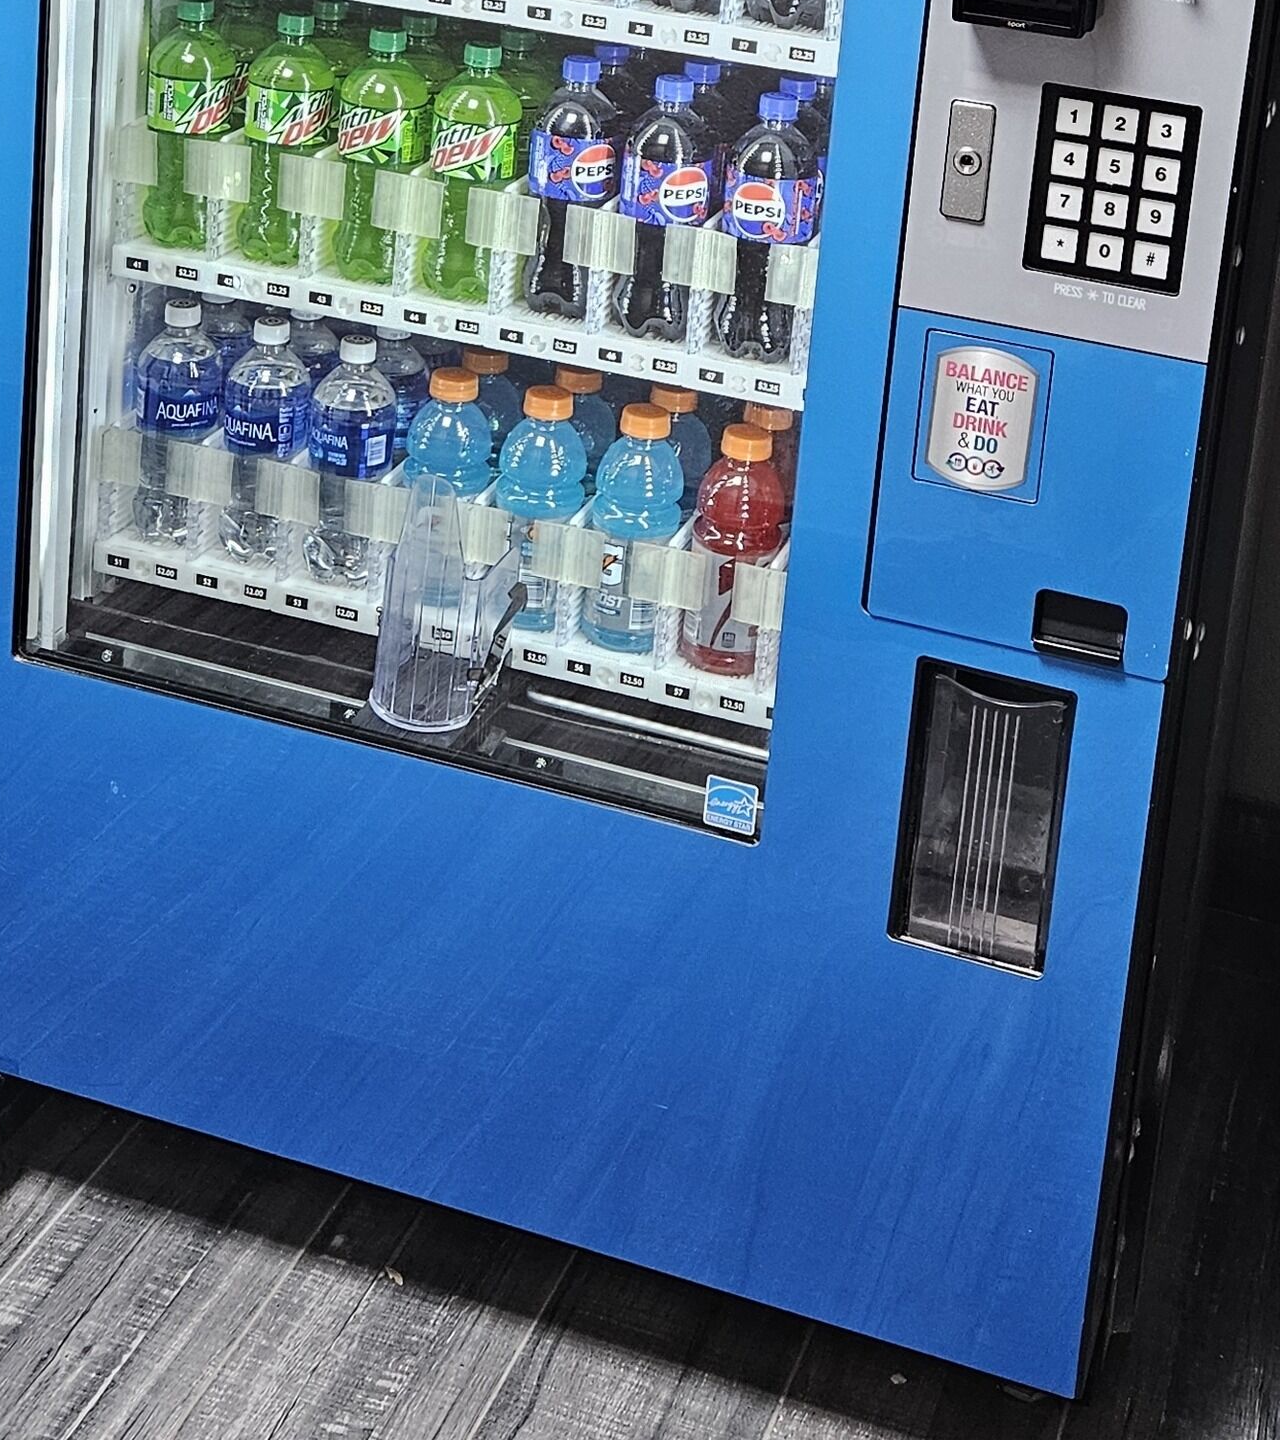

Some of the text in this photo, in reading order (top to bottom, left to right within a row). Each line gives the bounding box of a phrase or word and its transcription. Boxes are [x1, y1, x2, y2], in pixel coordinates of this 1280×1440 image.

[1070, 108, 1173, 139] 1 2 3
[1062, 150, 1167, 182] 4 5 6
[663, 186, 707, 202] PEPSI
[734, 199, 782, 219] PEPSI
[1058, 193, 1162, 225] 7 8 9
[1098, 243, 1111, 259] 0
[132, 260, 288, 296] 41 $2.25
[1053, 282, 1147, 312] PRESS TO CLEAR
[945, 361, 1030, 392] BALANCE
[955, 380, 1016, 403] WHAT YOU
[155, 400, 219, 421] AQUAFINA
[952, 412, 1009, 439] DRINK
[957, 431, 999, 455] & DO
[157, 566, 643, 687] $2.00 $2.50
